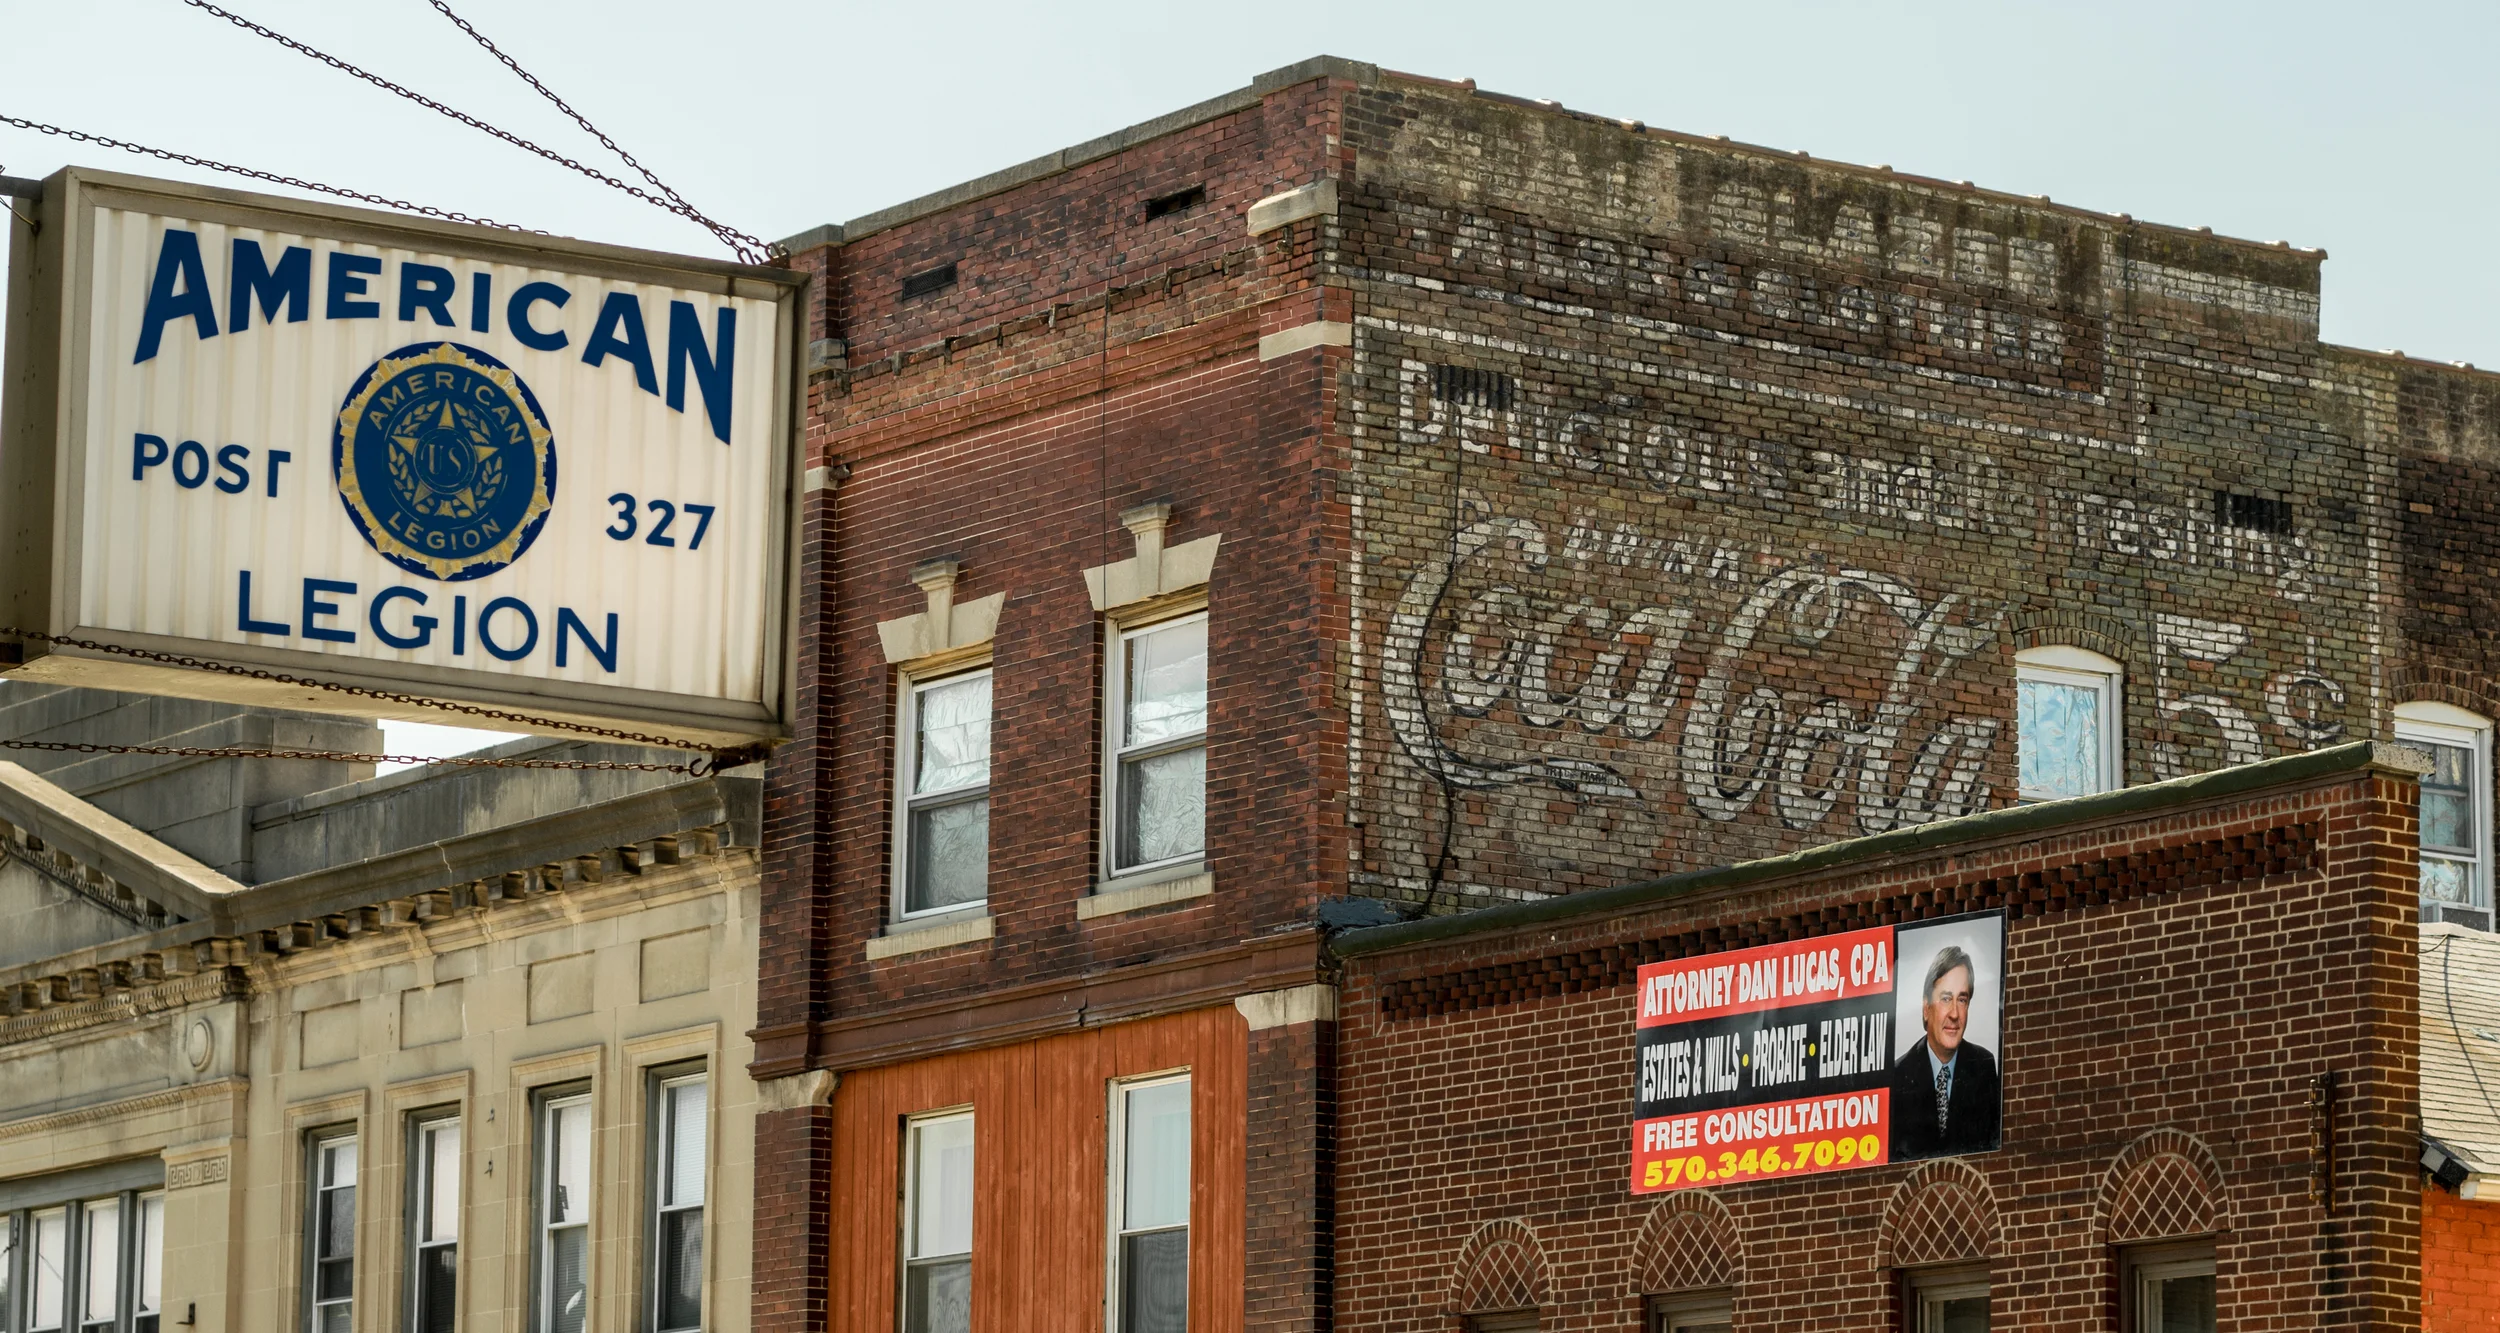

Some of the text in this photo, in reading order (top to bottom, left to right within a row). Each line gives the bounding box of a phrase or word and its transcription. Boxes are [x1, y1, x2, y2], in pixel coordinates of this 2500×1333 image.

[133, 228, 737, 446] AMERICAN
[369, 371, 525, 445] AMERICAN
[131, 433, 716, 551] POST 327
[387, 511, 501, 550] LEGION
[237, 570, 619, 674] LEGION
[1643, 941, 1889, 1017] ATTORNEY DAN LUCAS, CPA
[1641, 1012, 1888, 1103] ESTATES & WILLS PROBATE ELDER LAW
[1643, 1094, 1879, 1153] FREE CONSULTATION
[1643, 1133, 1881, 1188] 570.346.7090
